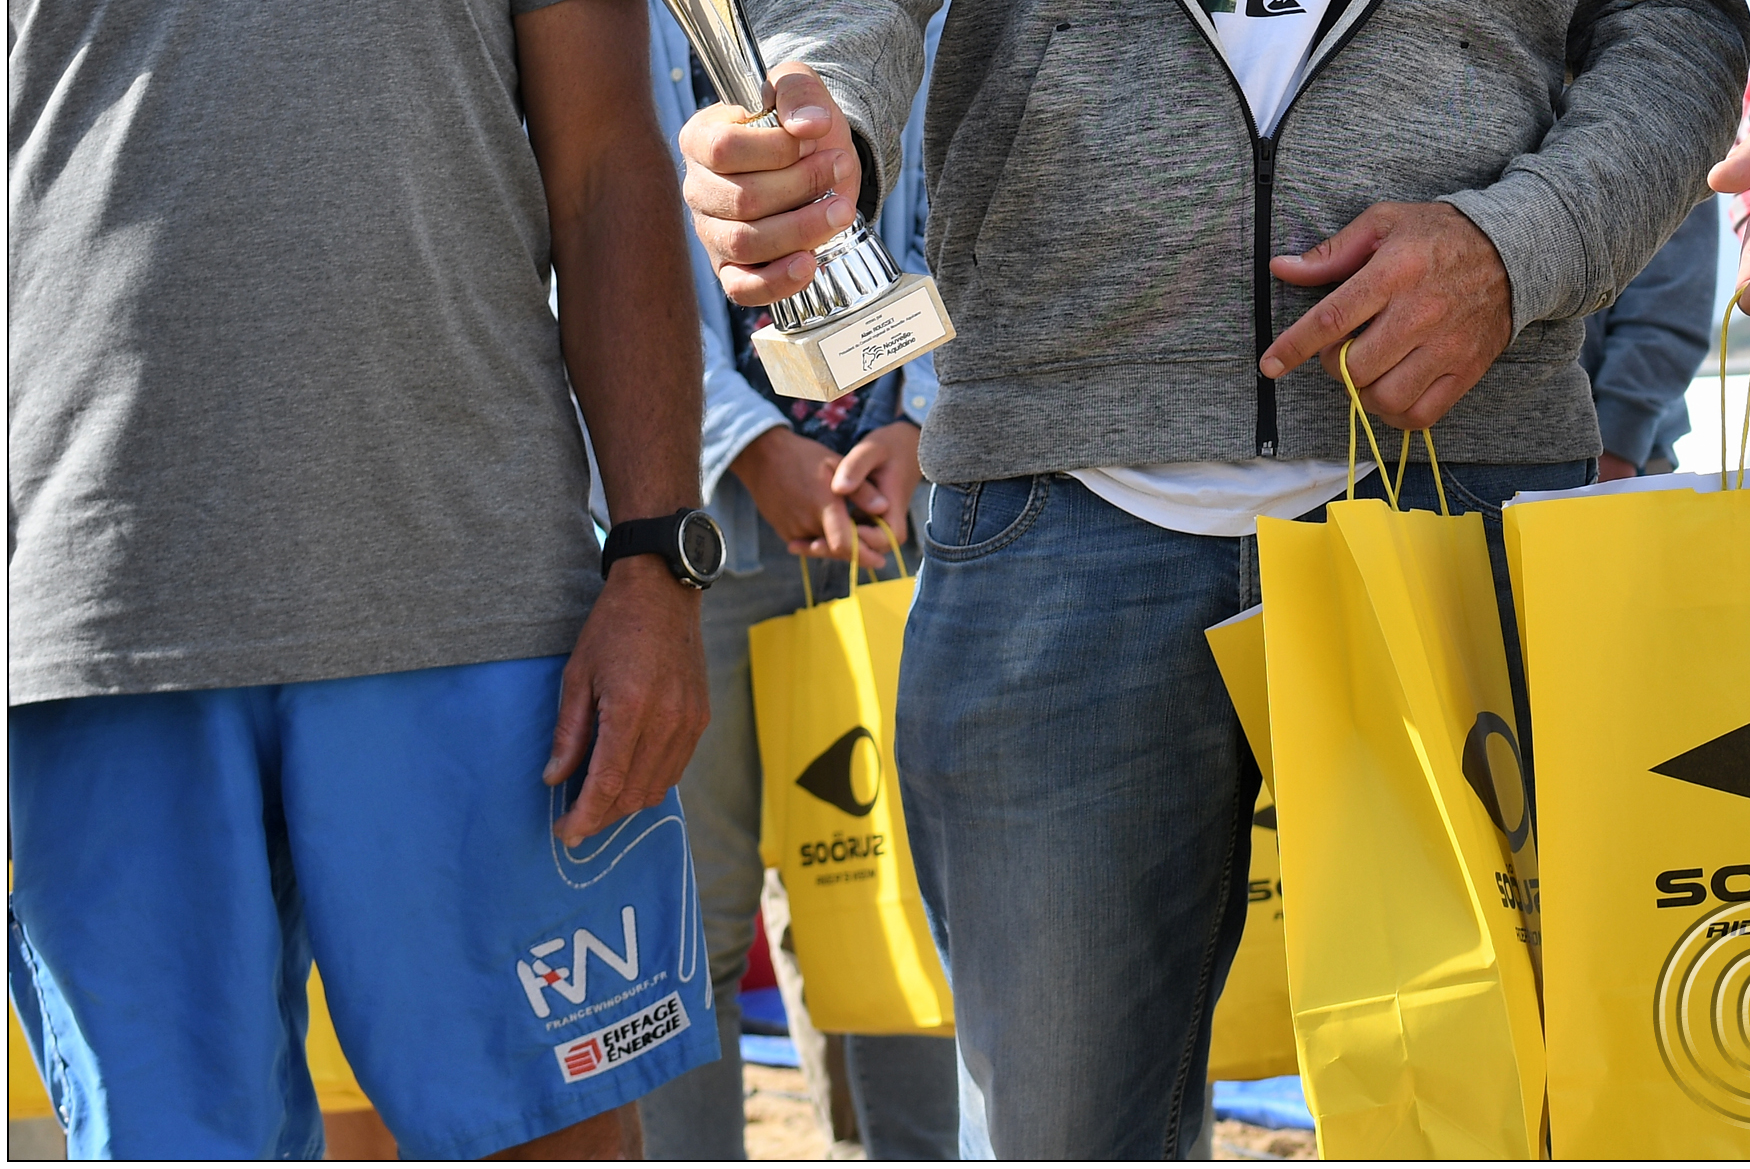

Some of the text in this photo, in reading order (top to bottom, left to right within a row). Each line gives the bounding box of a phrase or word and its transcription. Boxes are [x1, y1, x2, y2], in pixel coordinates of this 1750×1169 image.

[886, 337, 916, 357] Aquitaine
[545, 971, 668, 1031] FRANCEWINDSURF.FR
[602, 998, 680, 1048] EIFFAGE
